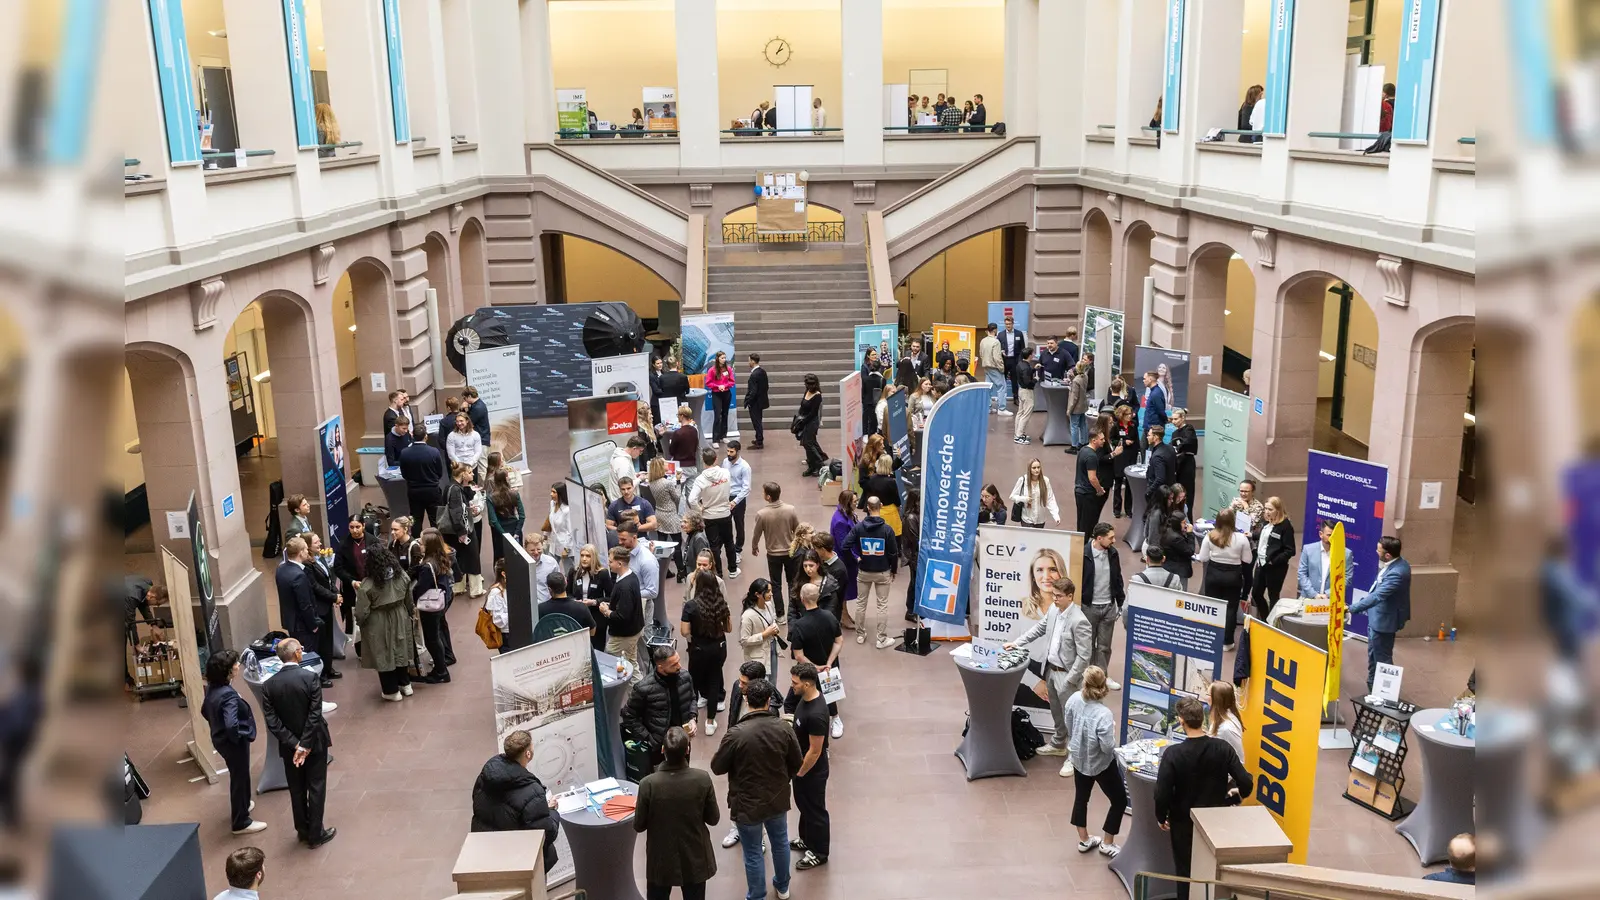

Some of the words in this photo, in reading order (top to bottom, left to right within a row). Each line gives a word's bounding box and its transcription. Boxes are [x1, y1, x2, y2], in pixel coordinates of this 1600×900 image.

[1320, 468, 1344, 478] PERSCH
[1345, 474, 1372, 484] CONSULT
[931, 434, 954, 550] Hannoversche
[1318, 493, 1358, 509] Bewertung
[950, 470, 971, 552] Volksbank
[1317, 509, 1355, 524] Immobilien
[986, 544, 1016, 556] CEV
[986, 568, 1021, 581] Bereit
[986, 583, 1003, 592] für
[985, 595, 1022, 608] deinen
[1184, 601, 1218, 616] BUNTE
[985, 609, 1019, 620] neuen
[985, 621, 1011, 633] Job?
[974, 645, 990, 656] CEV
[536, 658, 550, 667] REAL
[551, 651, 570, 662] ESTATE
[1256, 649, 1298, 817] BUNTE
